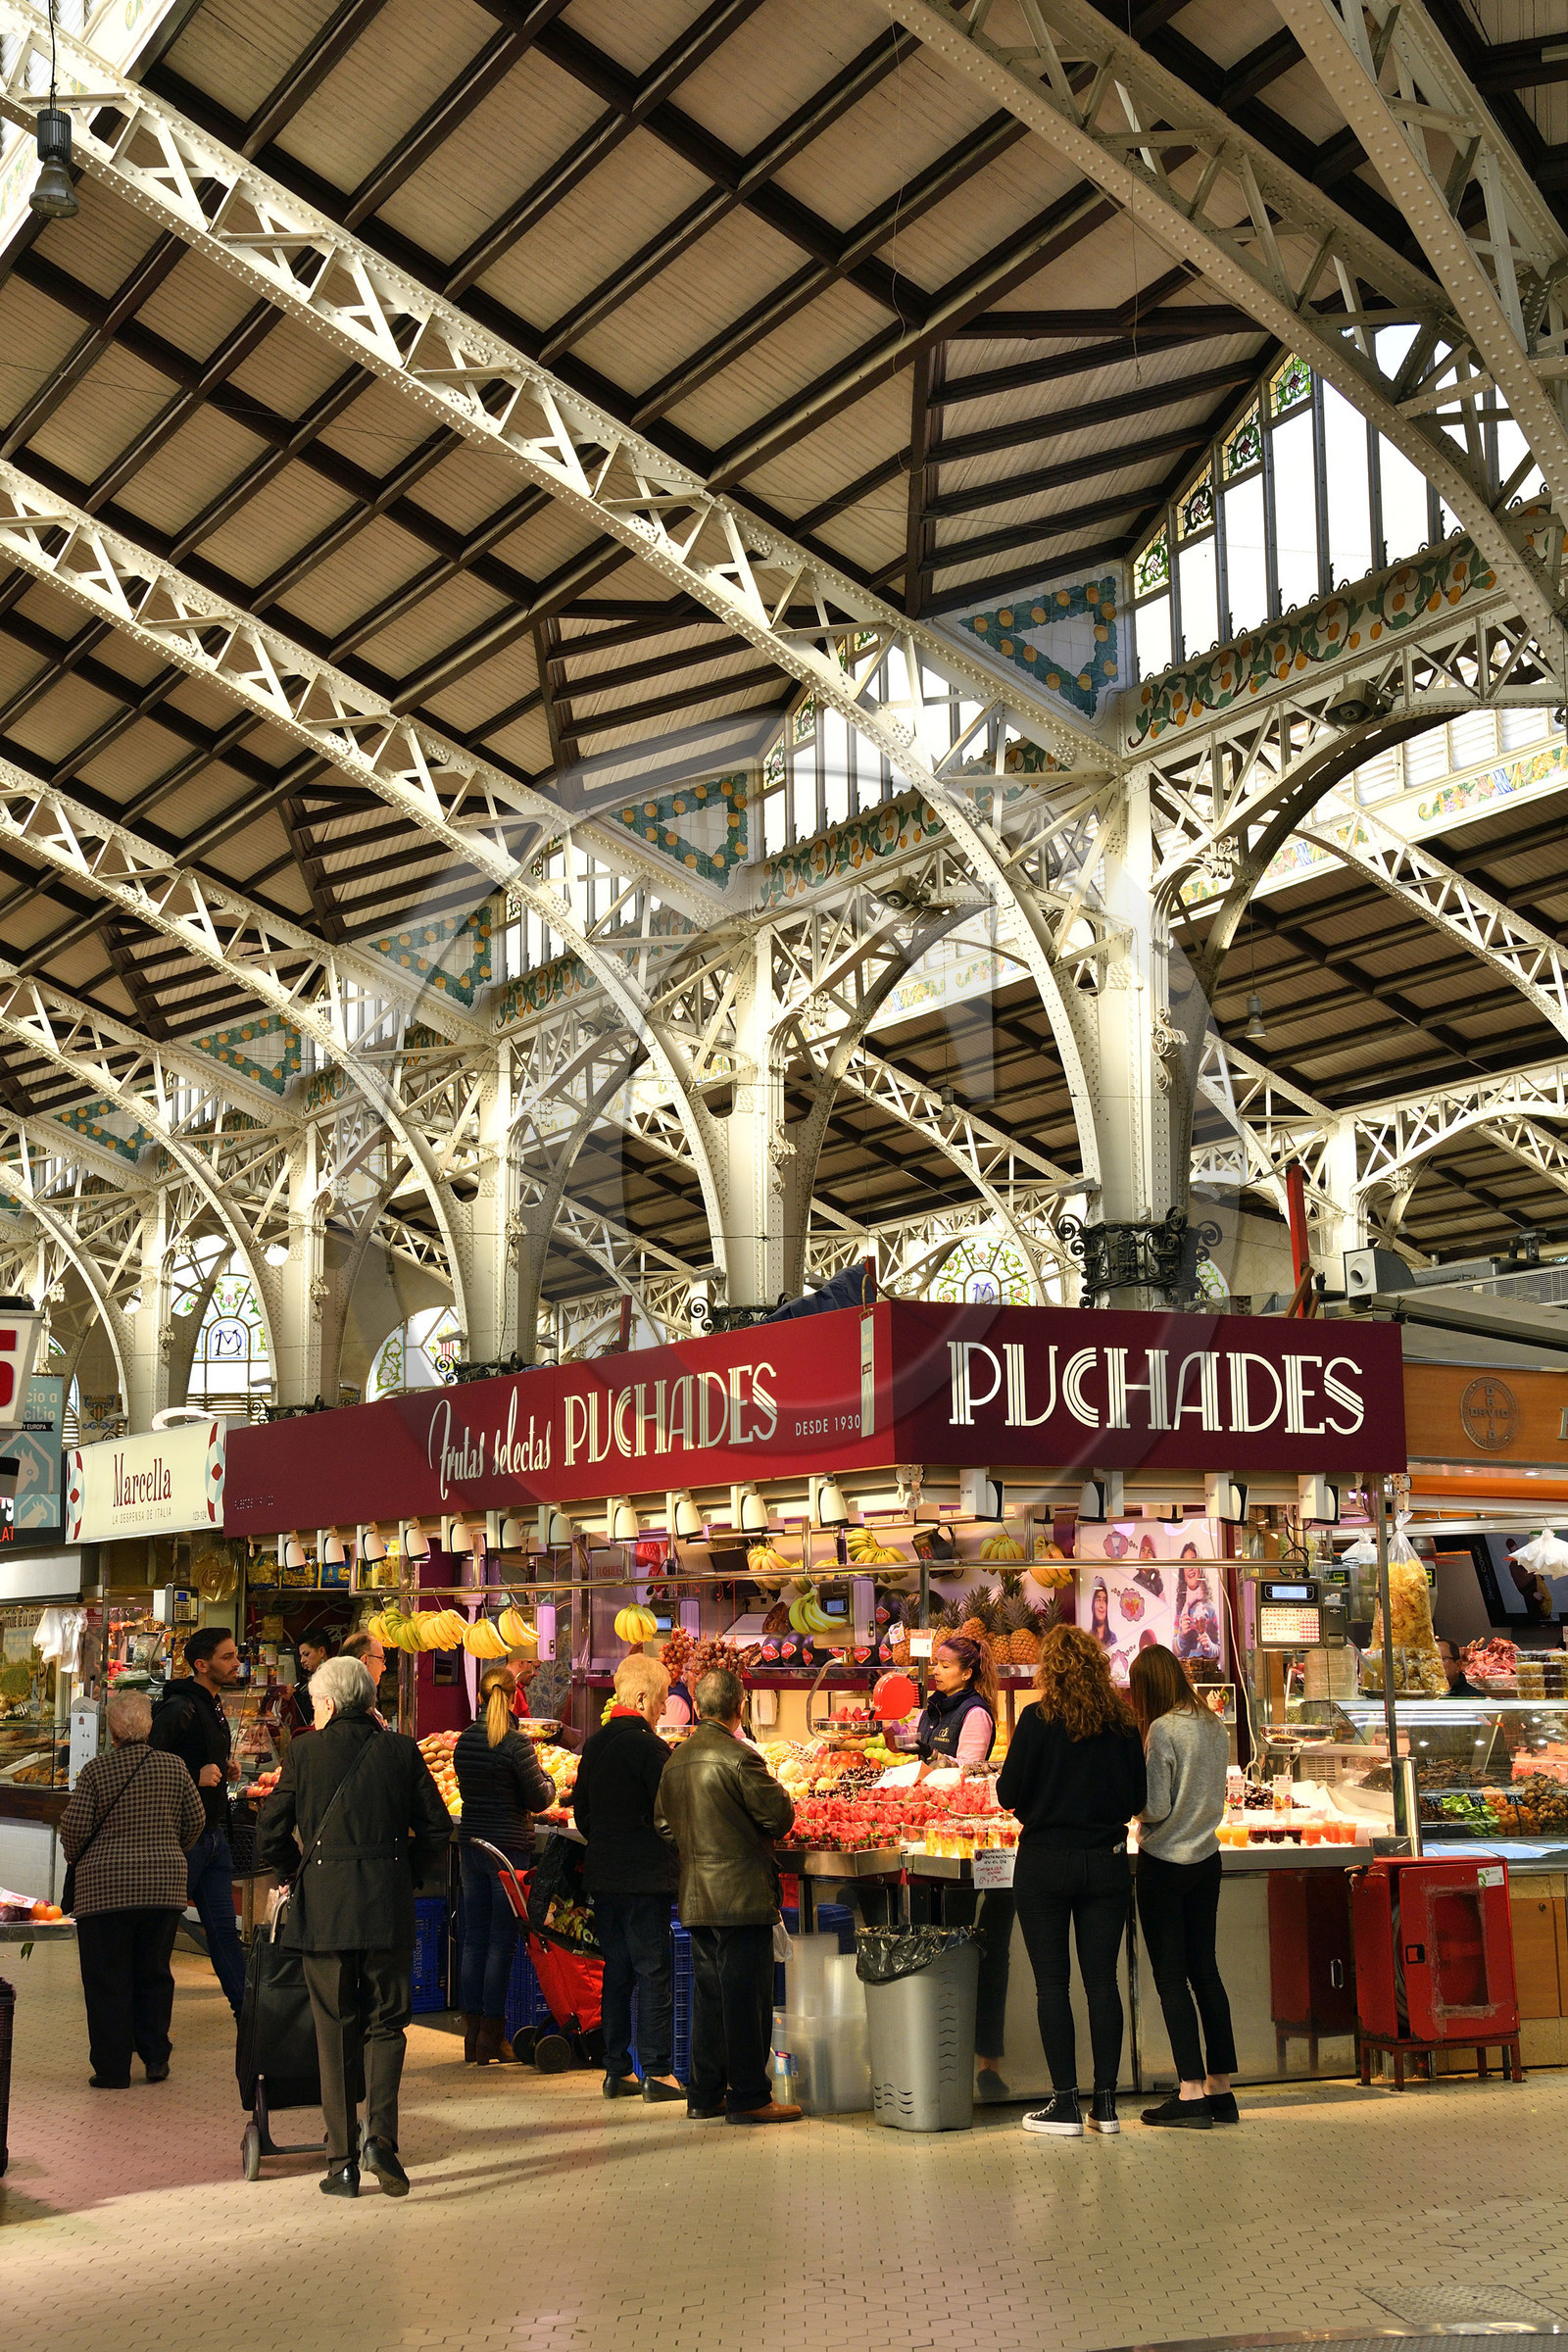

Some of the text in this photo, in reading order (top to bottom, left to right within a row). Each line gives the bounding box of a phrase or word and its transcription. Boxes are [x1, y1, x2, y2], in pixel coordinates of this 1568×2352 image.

[947, 1342, 1364, 1435] PUCHADES
[428, 1362, 778, 1500] Frutas selectas PUCHADES
[795, 1414, 860, 1437] DESDE 1930
[113, 1452, 172, 1508] Marcella
[112, 1506, 172, 1525] LA DESPENSA DE ITALIA
